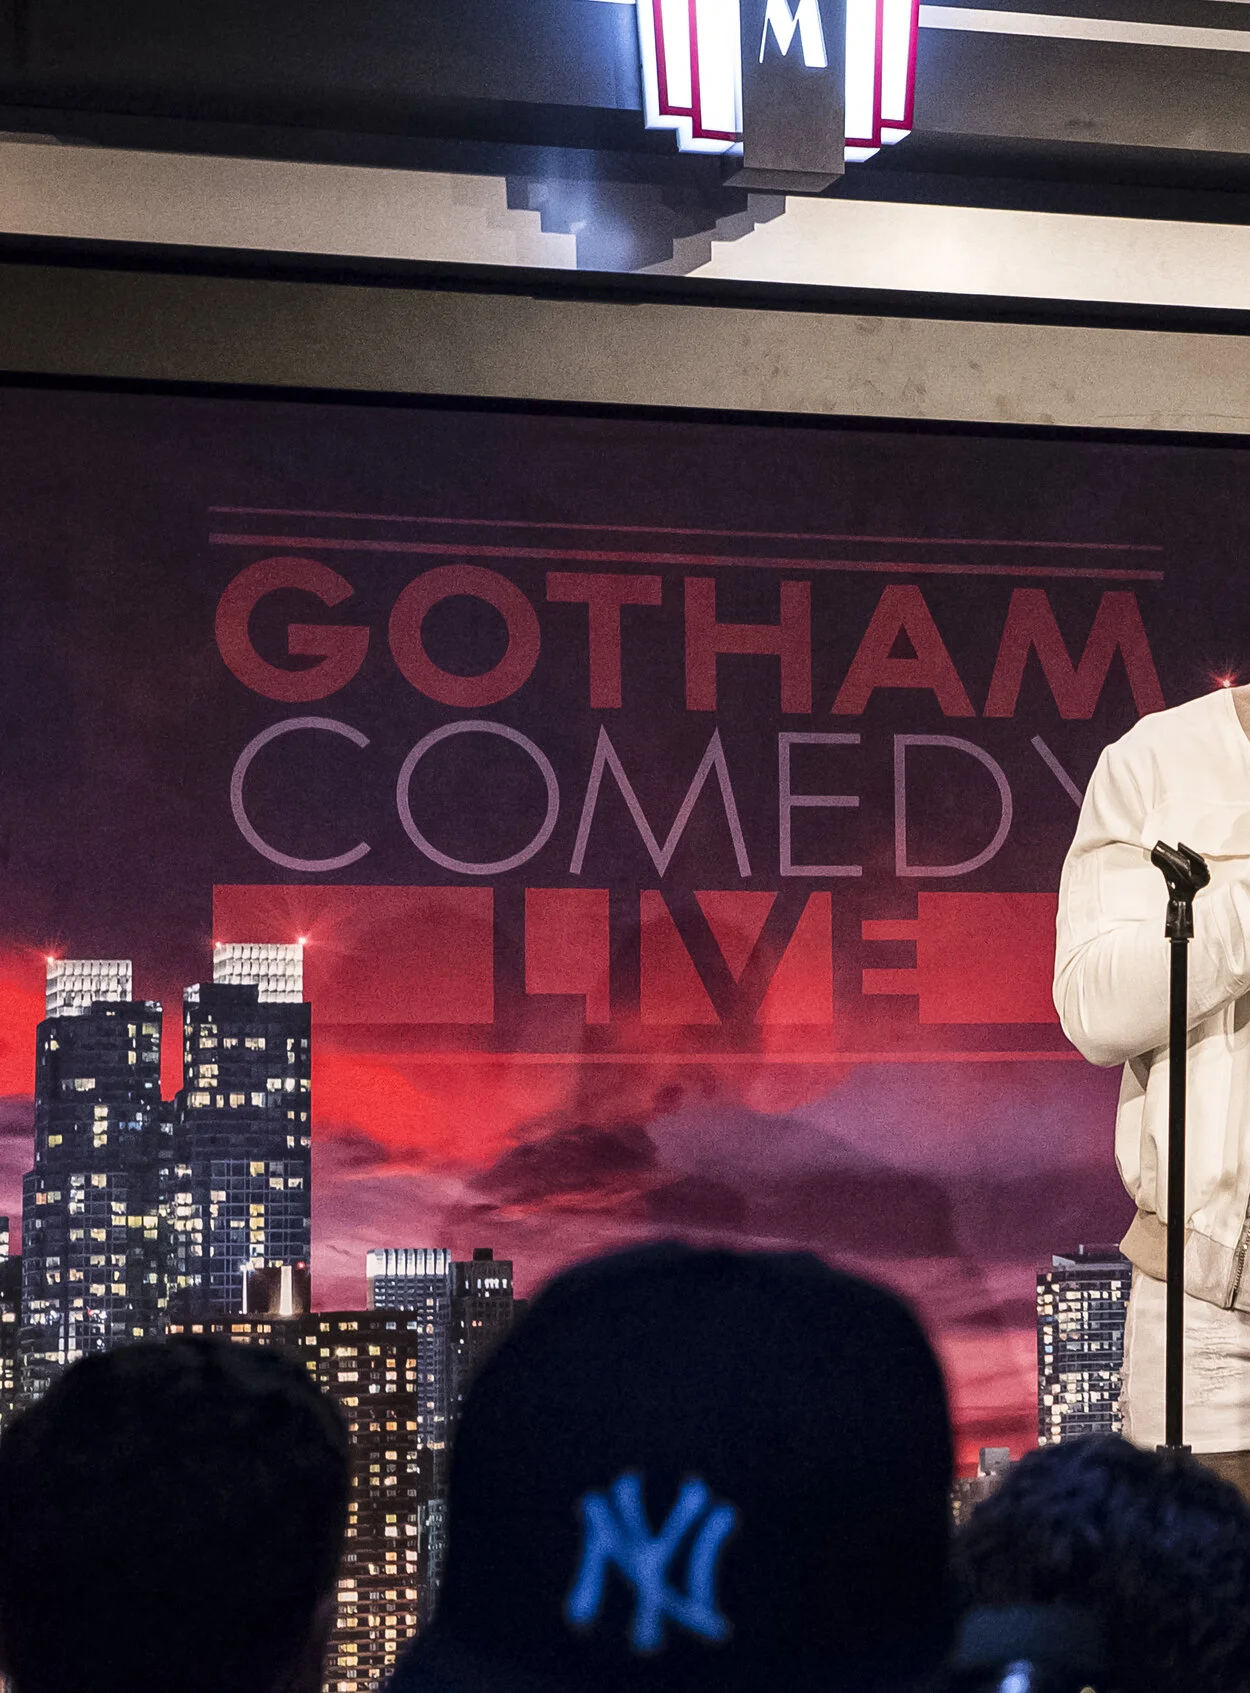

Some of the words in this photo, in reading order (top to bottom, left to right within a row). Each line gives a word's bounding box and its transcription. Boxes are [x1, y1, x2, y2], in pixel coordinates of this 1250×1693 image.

[214, 556, 1167, 720] GOTHAM
[493, 887, 919, 1027] LIVE
[567, 1475, 736, 1650] NY
